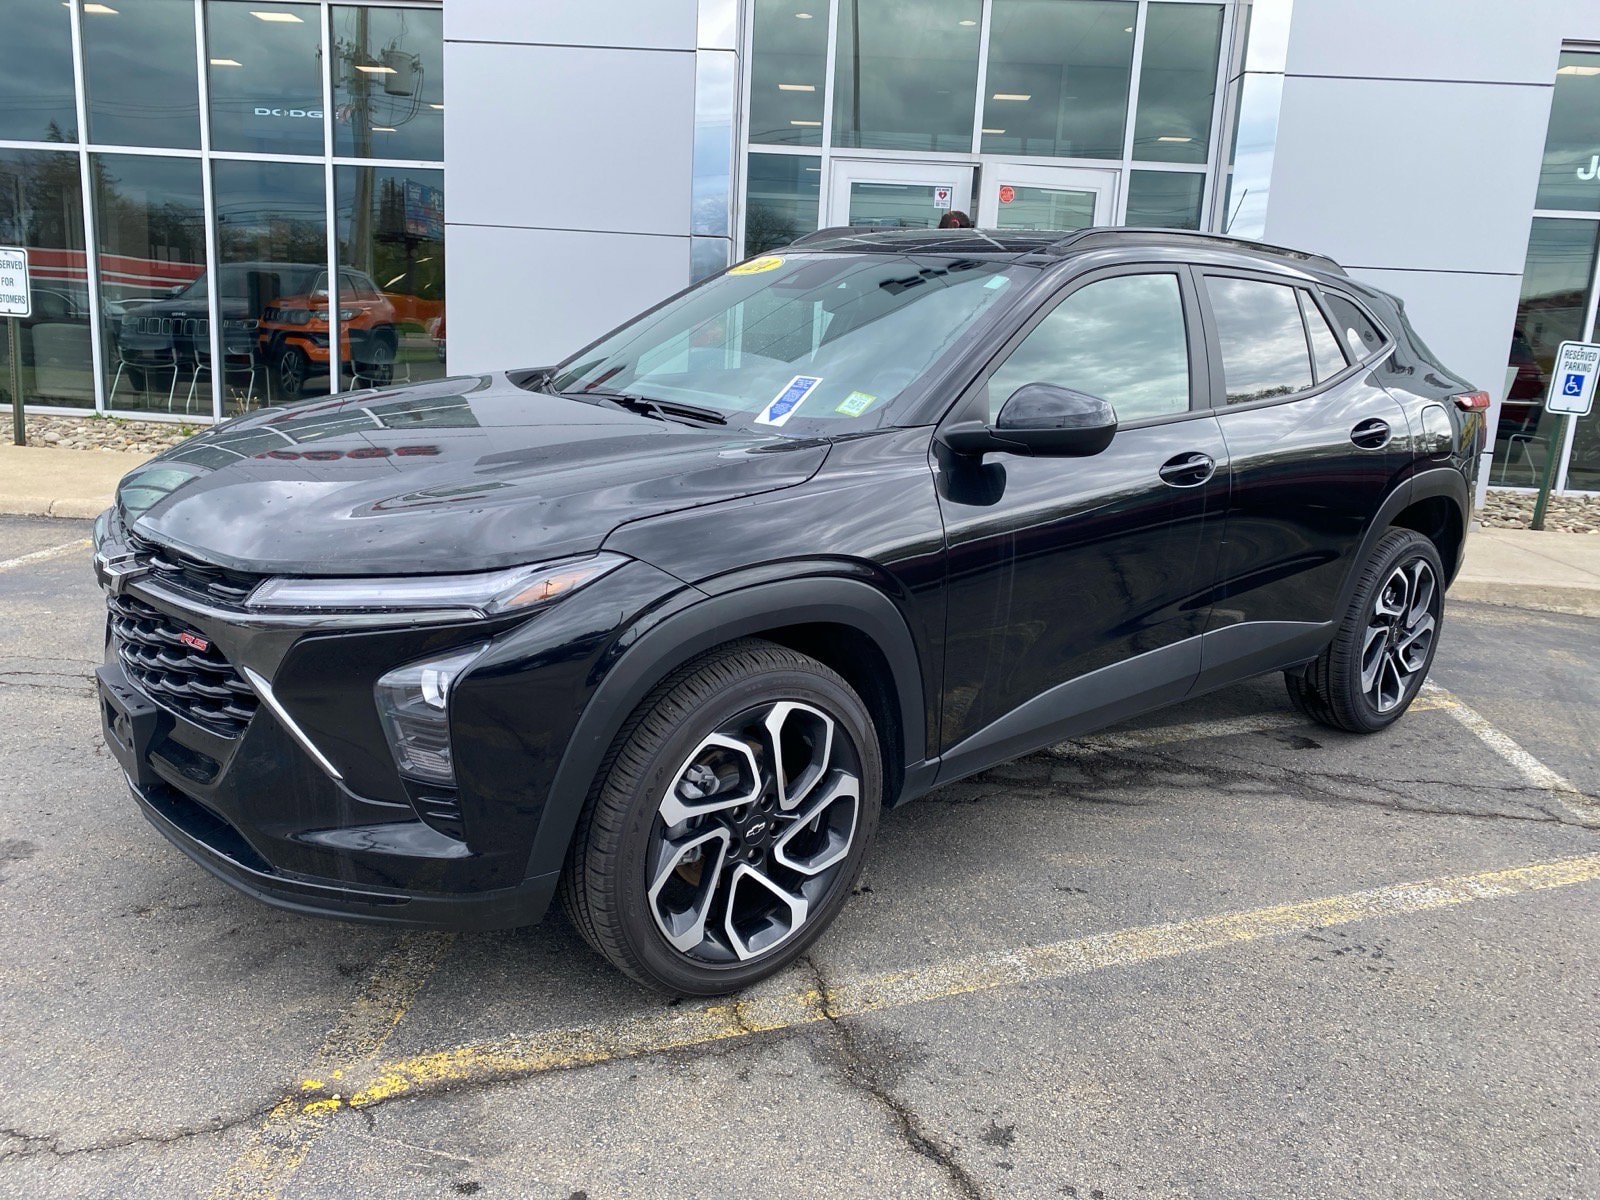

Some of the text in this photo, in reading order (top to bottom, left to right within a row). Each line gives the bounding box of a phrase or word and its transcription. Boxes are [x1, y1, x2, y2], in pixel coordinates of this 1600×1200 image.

[254, 107, 339, 119] DODG
[1577, 155, 1600, 180] J
[1, 277, 14, 287] FOR
[1564, 350, 1597, 361] RESERVED
[1564, 361, 1592, 372] PARKING
[180, 632, 208, 651] RS
